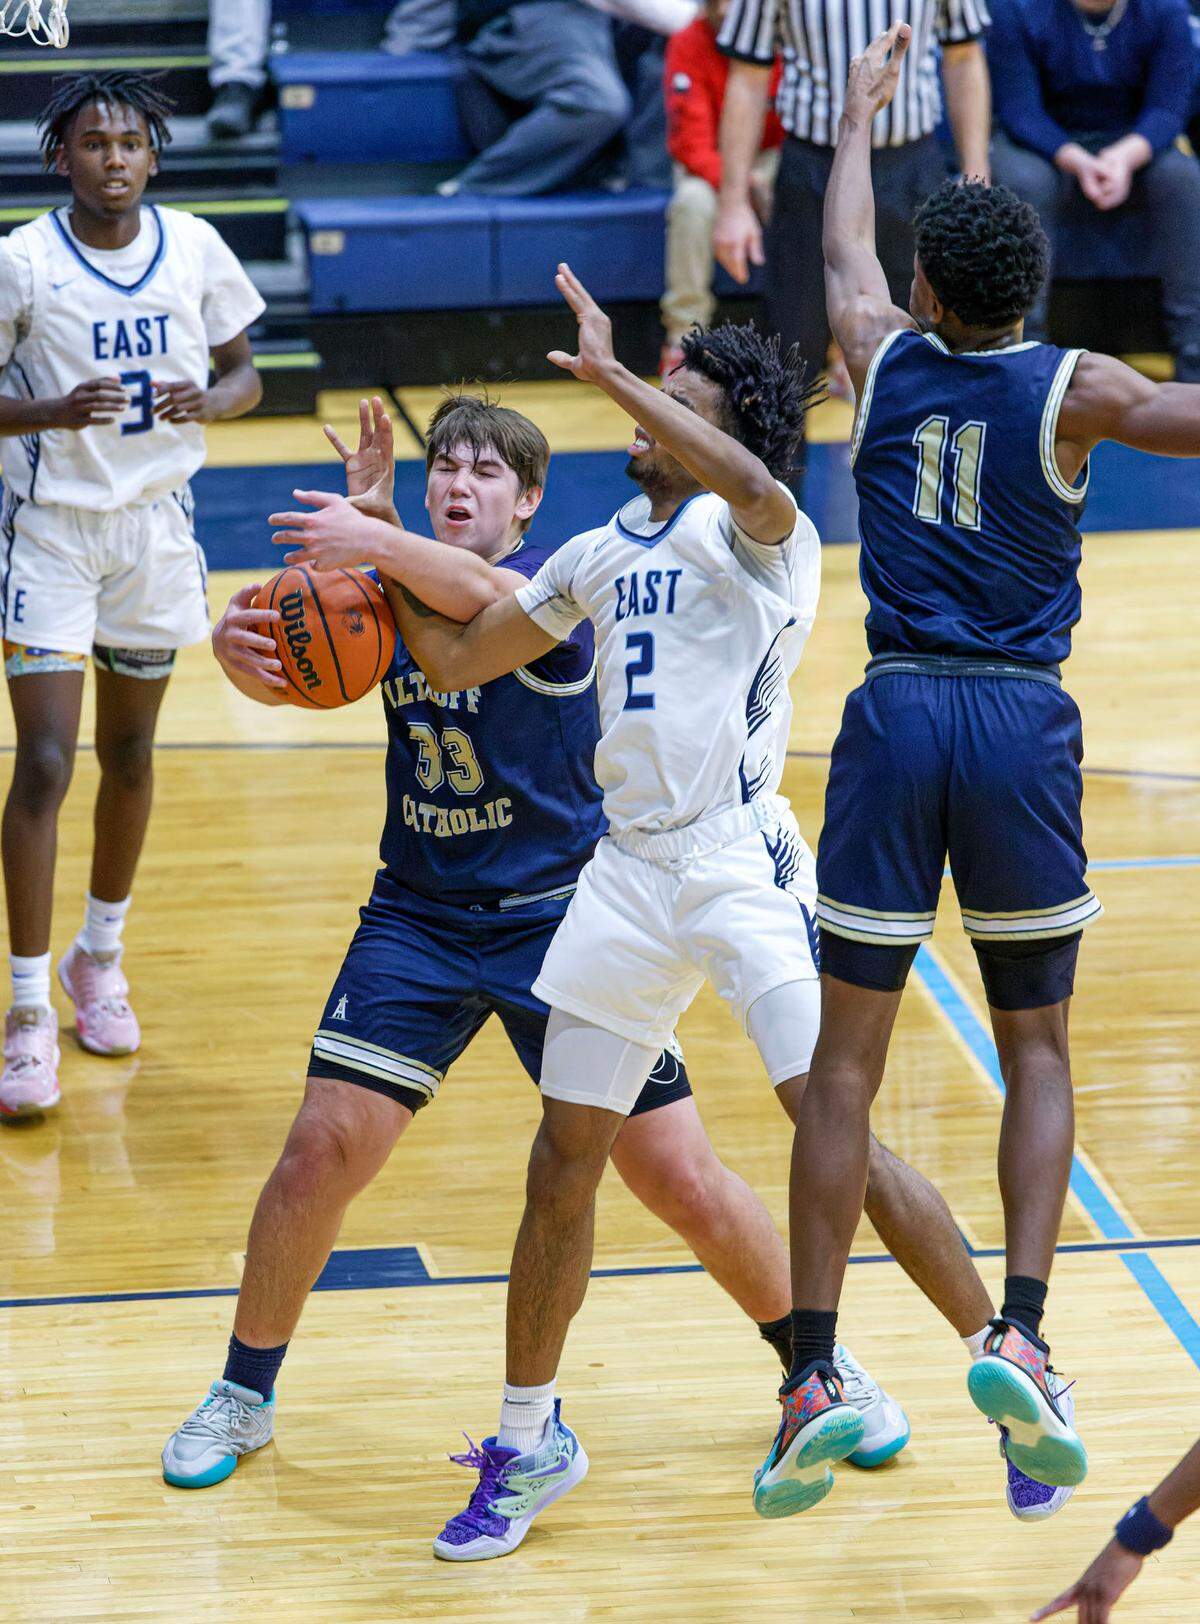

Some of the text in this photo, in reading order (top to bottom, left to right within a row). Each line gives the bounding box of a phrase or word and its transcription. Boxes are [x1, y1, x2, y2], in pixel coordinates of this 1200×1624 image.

[93, 314, 169, 360] EAST
[119, 370, 154, 436] 3
[912, 414, 987, 532] 11
[13, 588, 26, 622] E
[614, 568, 682, 622] EAST
[279, 589, 322, 690] Wilson
[623, 630, 656, 711] 2
[407, 722, 485, 795] 33
